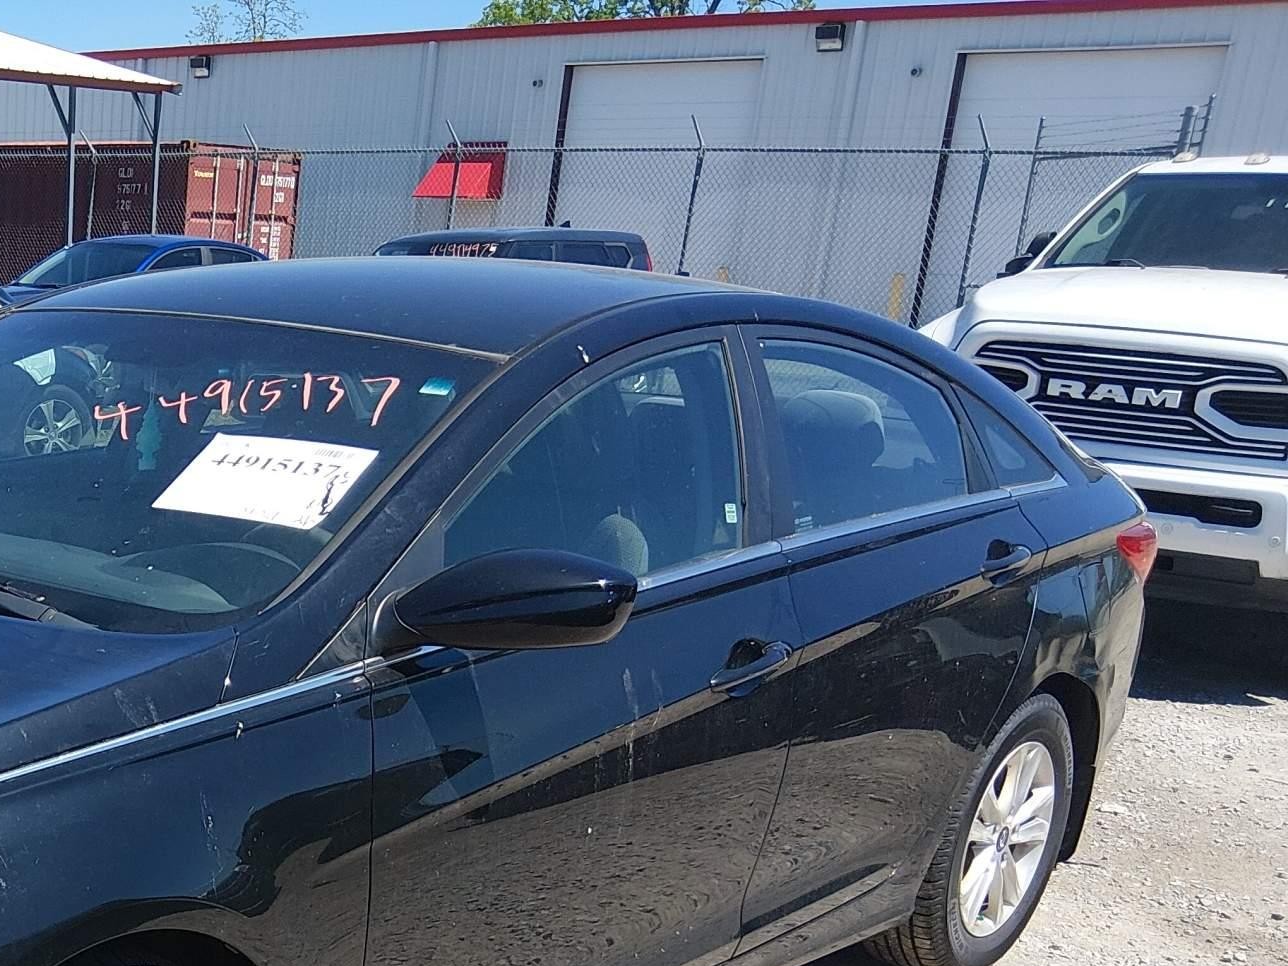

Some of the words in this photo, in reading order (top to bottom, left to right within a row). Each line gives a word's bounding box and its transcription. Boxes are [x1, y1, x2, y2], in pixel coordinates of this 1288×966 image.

[94, 372, 401, 441] 44915137
[1046, 378, 1183, 409] RAM
[211, 452, 342, 480] 44915137
